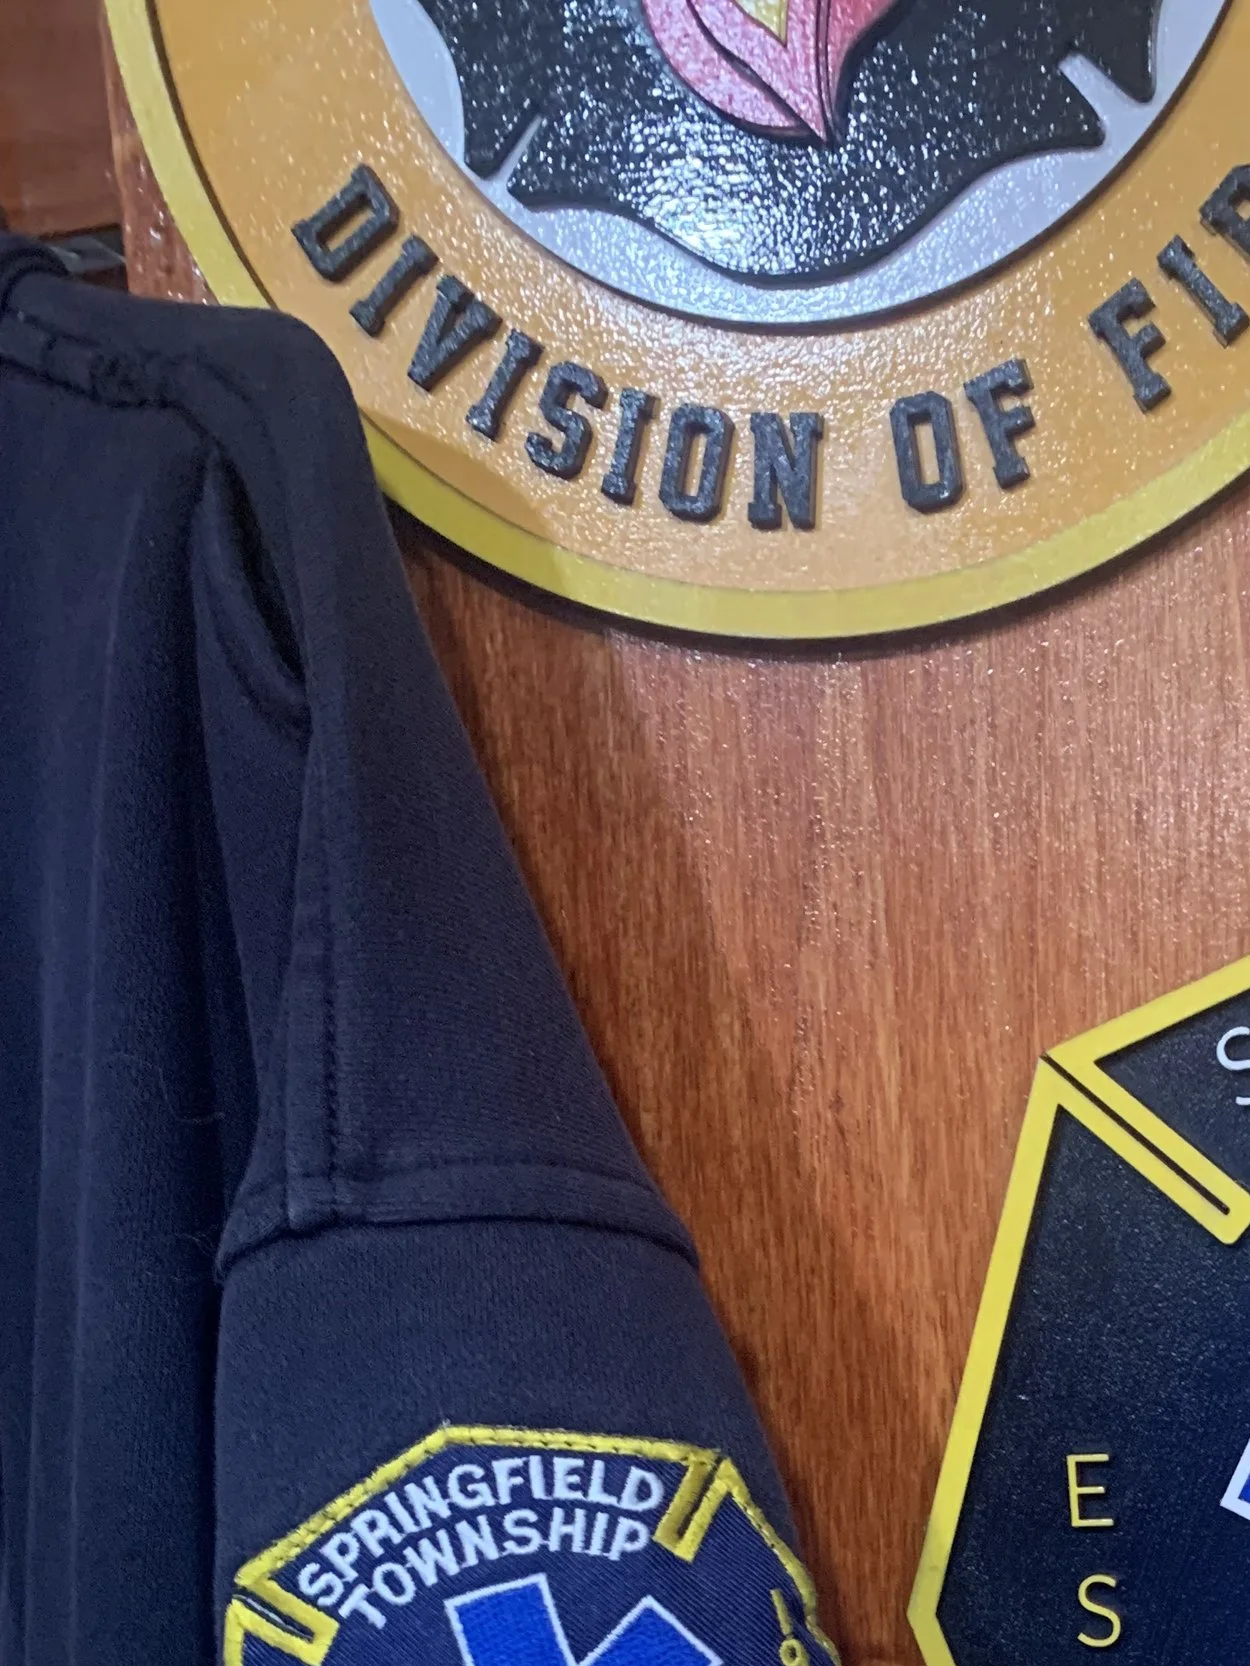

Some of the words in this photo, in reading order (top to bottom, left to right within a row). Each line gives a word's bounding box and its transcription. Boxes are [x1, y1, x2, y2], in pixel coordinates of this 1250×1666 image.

[291, 162, 823, 530] DIVISION
[889, 358, 1036, 514] OF
[298, 1455, 664, 1607] SPRINGFIELD
[340, 1507, 651, 1628] TOWNSHIP
